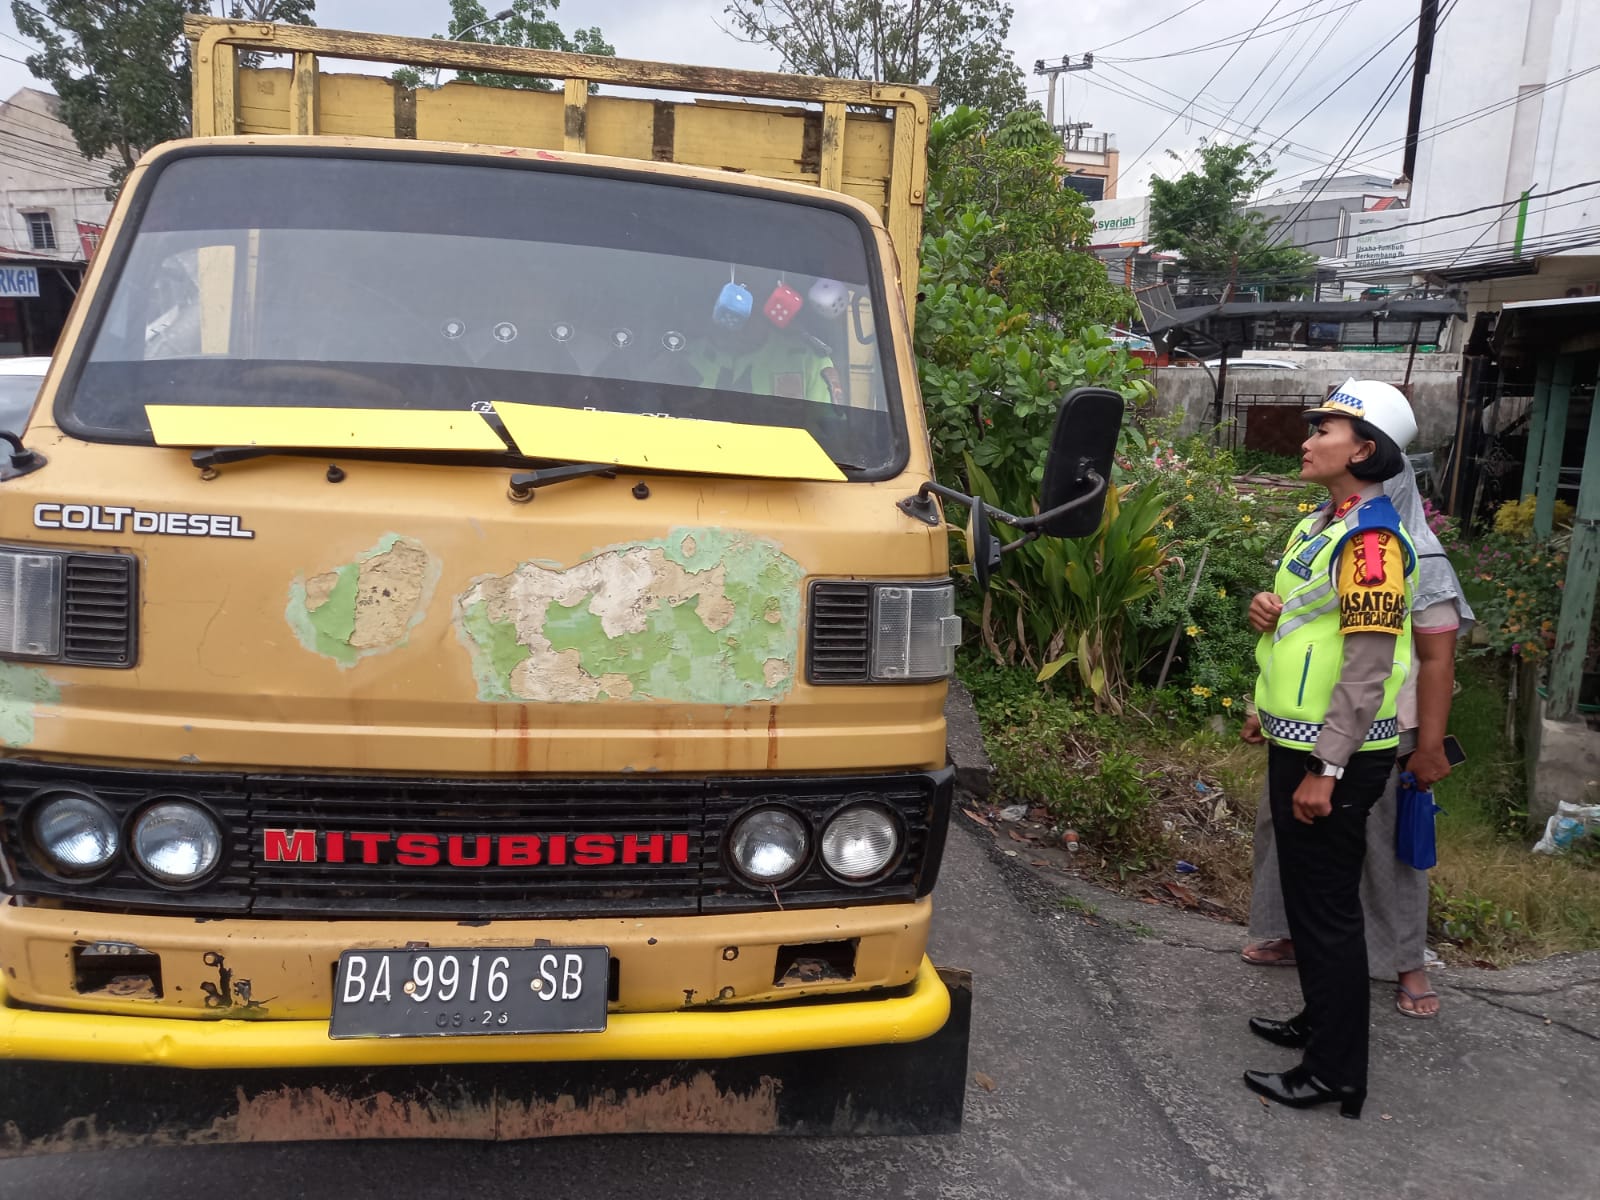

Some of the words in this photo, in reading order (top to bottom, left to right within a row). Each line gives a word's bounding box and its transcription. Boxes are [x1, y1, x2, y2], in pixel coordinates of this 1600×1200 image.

[263, 828, 689, 866] MITSUBISHI
[343, 955, 391, 1003] BA
[410, 955, 509, 1003] 9916
[537, 954, 583, 1001] SB
